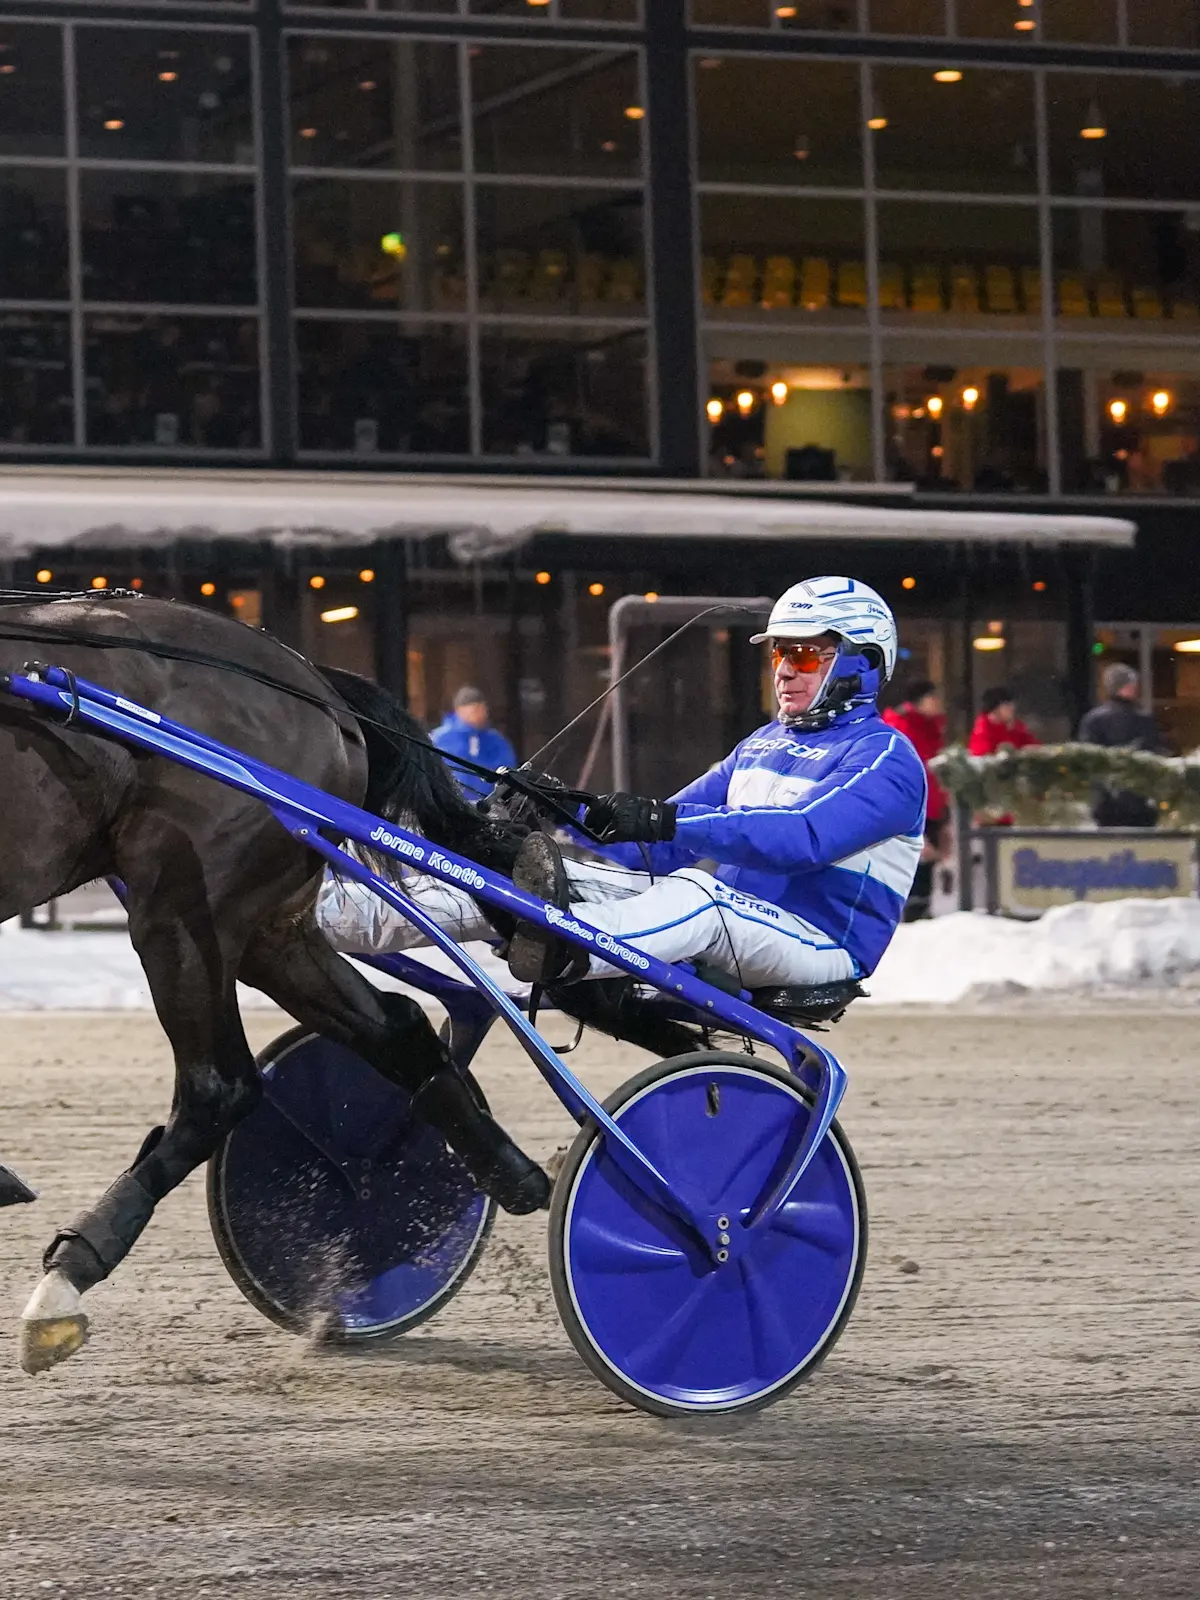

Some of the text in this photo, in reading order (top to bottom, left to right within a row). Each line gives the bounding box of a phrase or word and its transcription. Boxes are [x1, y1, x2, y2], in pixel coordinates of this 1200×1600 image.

[370, 826, 486, 890] Jorma Kontio
[543, 903, 650, 970] Custom Chrono
